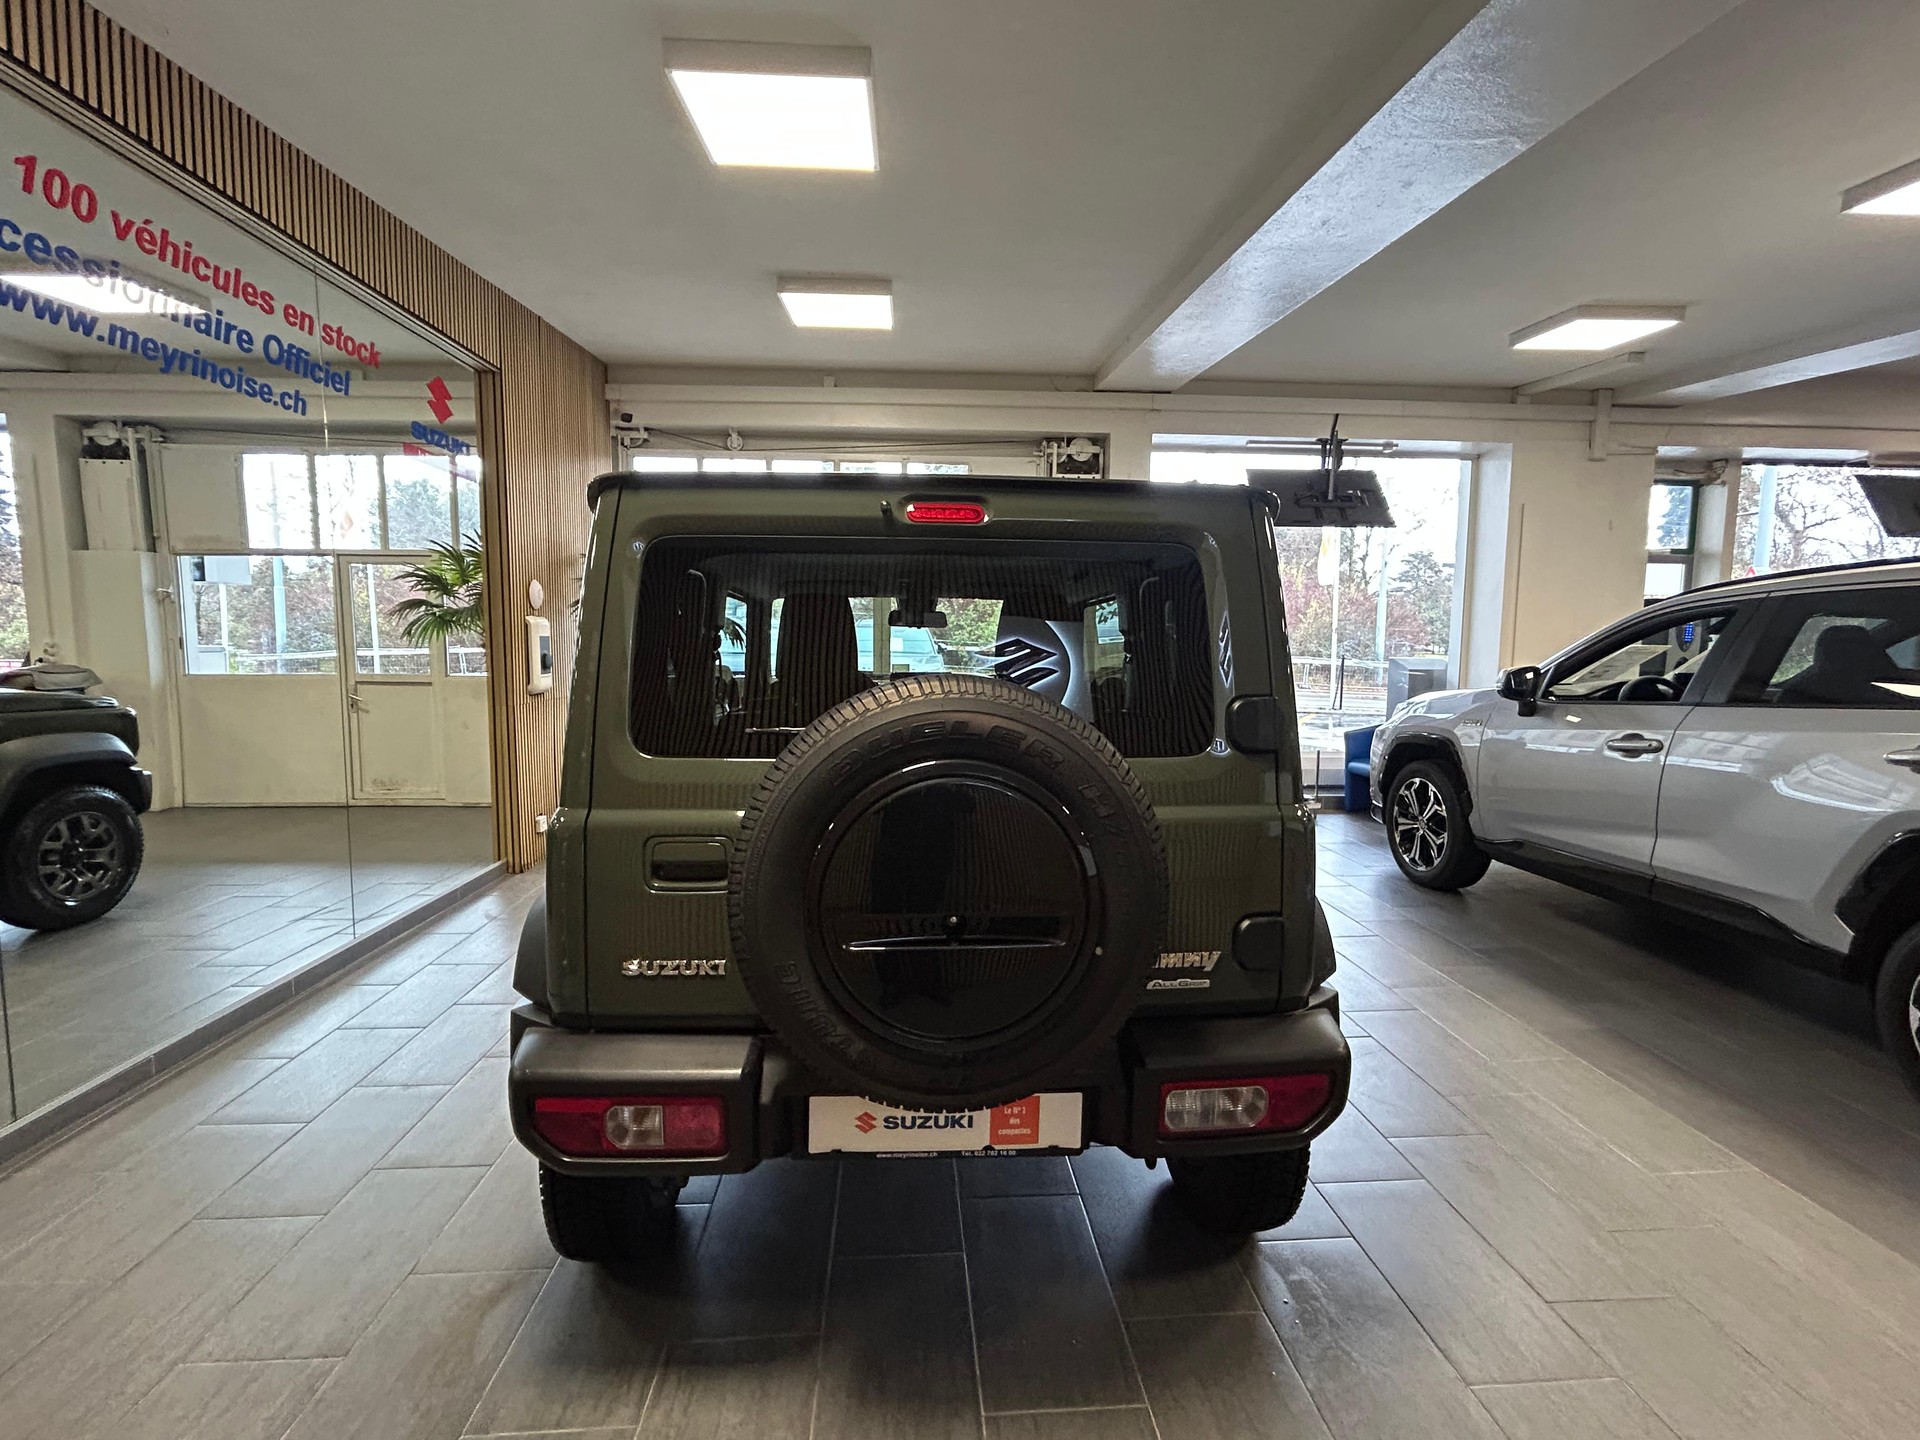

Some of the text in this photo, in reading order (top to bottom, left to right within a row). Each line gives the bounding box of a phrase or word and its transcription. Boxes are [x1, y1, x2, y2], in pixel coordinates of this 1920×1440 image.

[14, 155, 381, 369] 100 véhicules en stock
[0, 279, 307, 416] www.meyrinoise.ch
[262, 334, 351, 396] Officiel
[410, 420, 471, 456] SUZUKI
[830, 719, 1066, 787] DUELER
[621, 958, 728, 976] SUZUKI
[883, 1114, 974, 1130] SUZUKI
